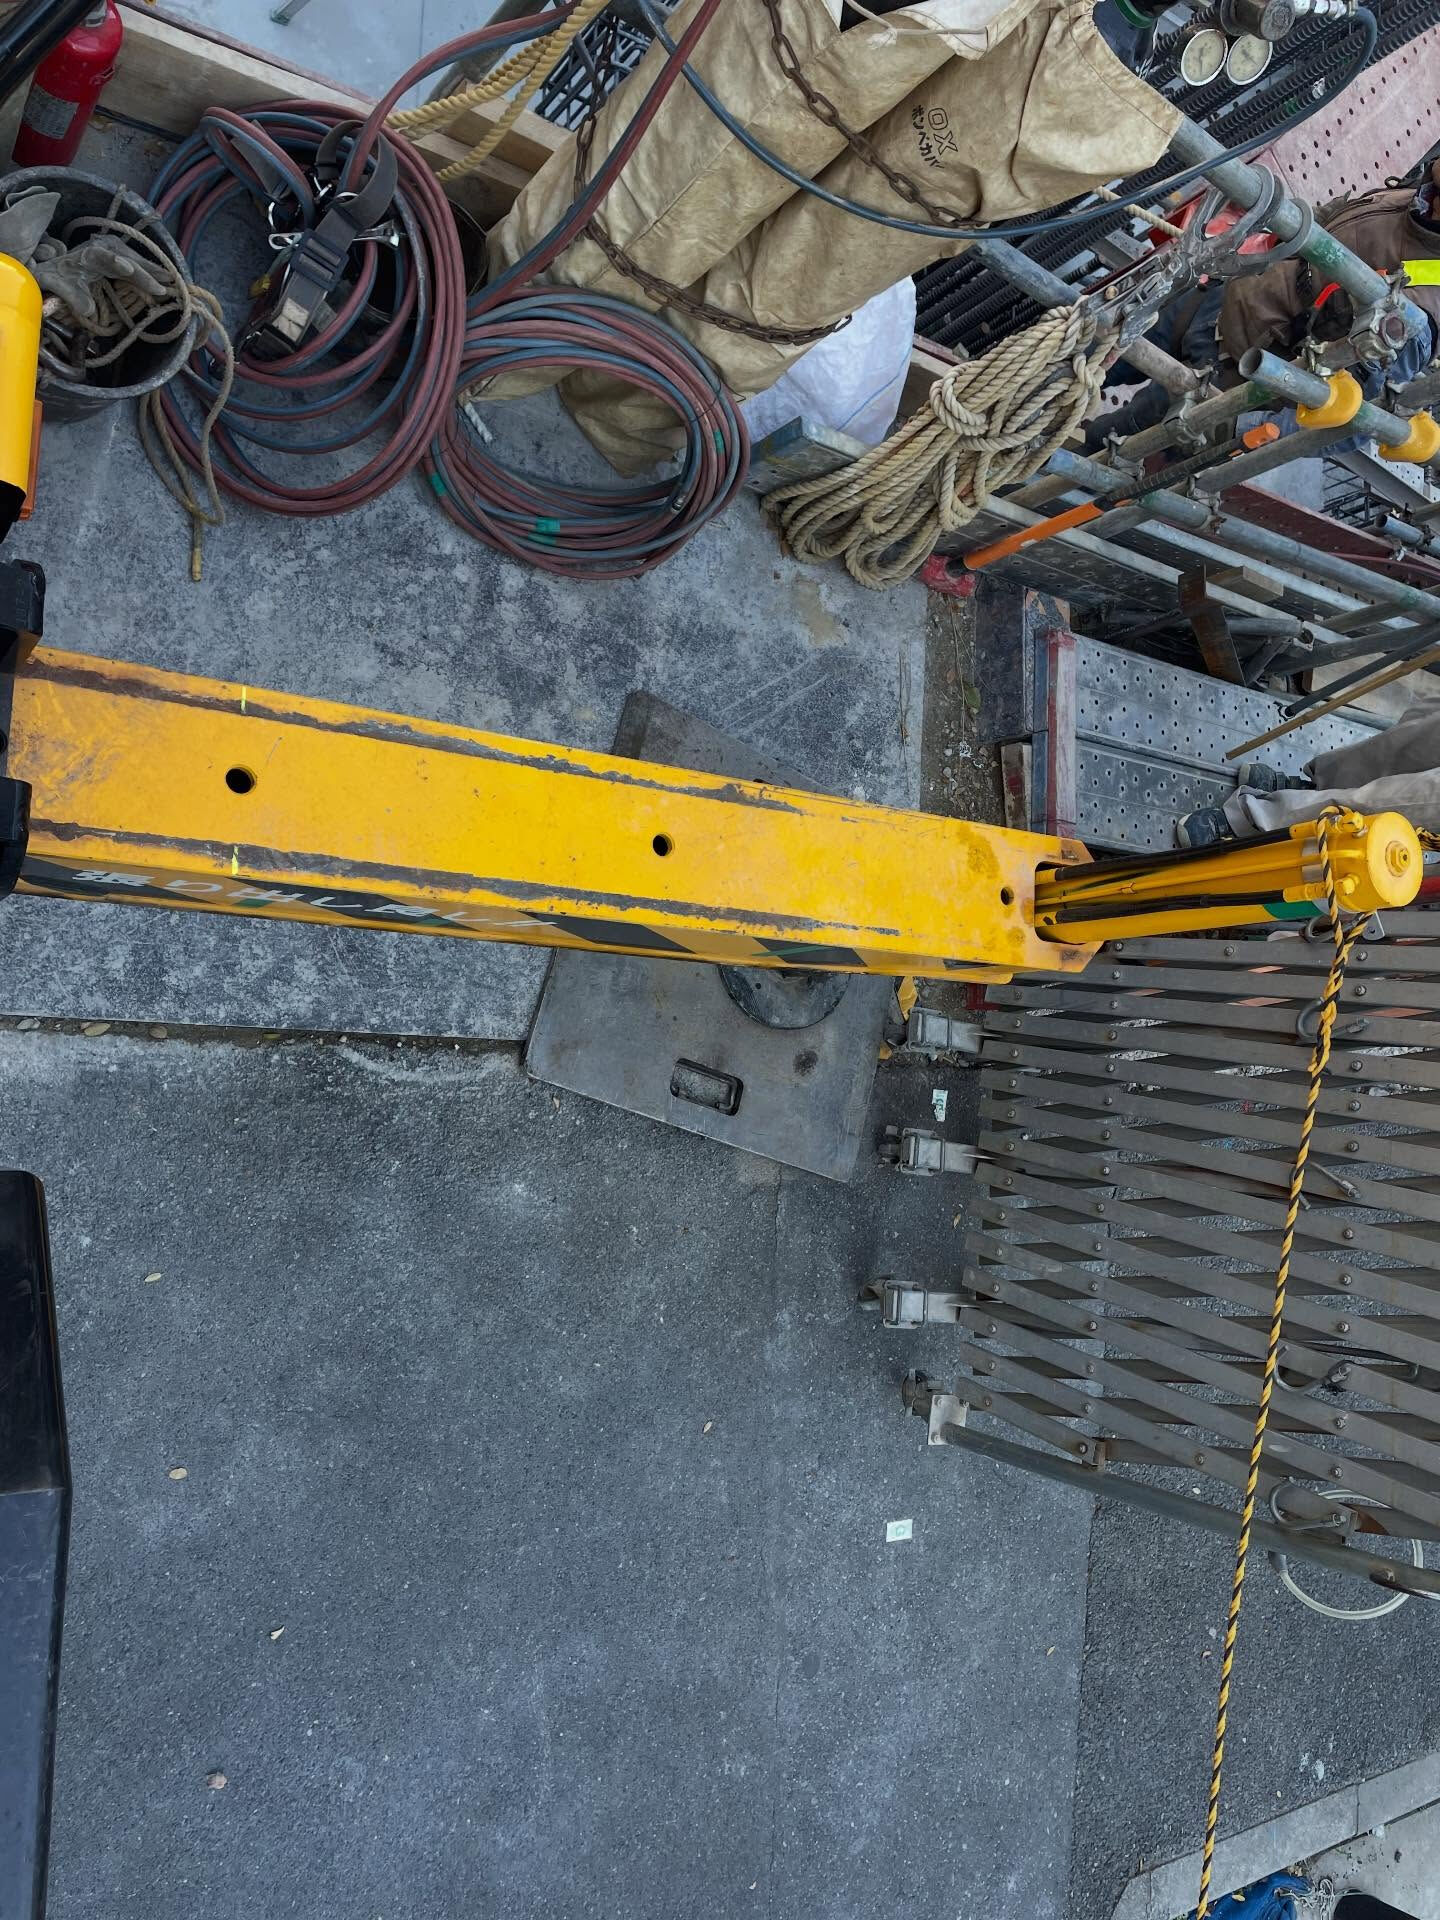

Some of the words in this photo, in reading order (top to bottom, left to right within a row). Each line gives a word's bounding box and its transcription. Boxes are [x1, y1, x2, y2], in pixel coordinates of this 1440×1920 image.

[911, 104, 945, 169] ボンベカバー
